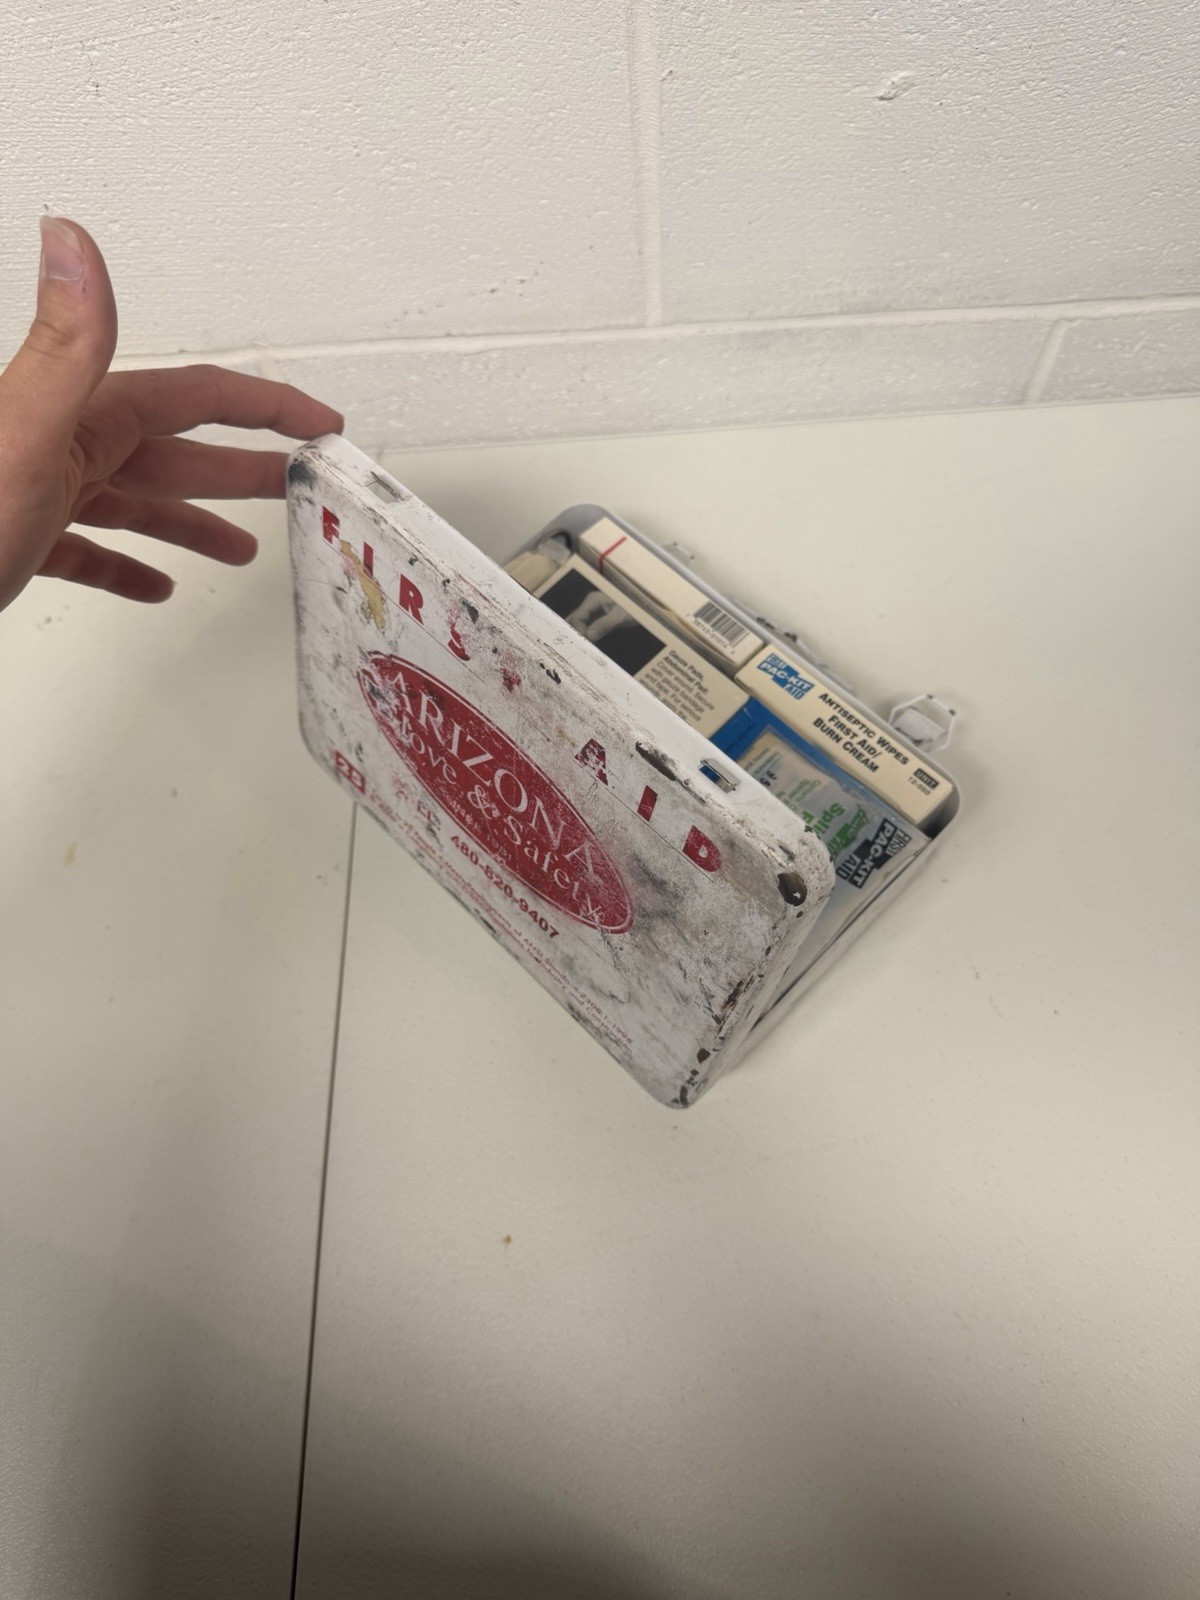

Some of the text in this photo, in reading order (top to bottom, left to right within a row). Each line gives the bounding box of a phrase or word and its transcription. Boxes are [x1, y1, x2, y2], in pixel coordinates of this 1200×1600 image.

[758, 660, 814, 692] PAC-KIT
[812, 717, 879, 773] BURN CREAM
[818, 692, 910, 766] ANTISEPTIC WIPES
[828, 714, 882, 760] FIRST AID/
[388, 667, 603, 880] ARIZONA
[574, 738, 722, 872] AID
[450, 834, 560, 939] 480-820-9407
[466, 783, 502, 820] &
[503, 813, 605, 926] Safety
[836, 854, 860, 880] AID
[850, 820, 898, 887] PAC-KIT
